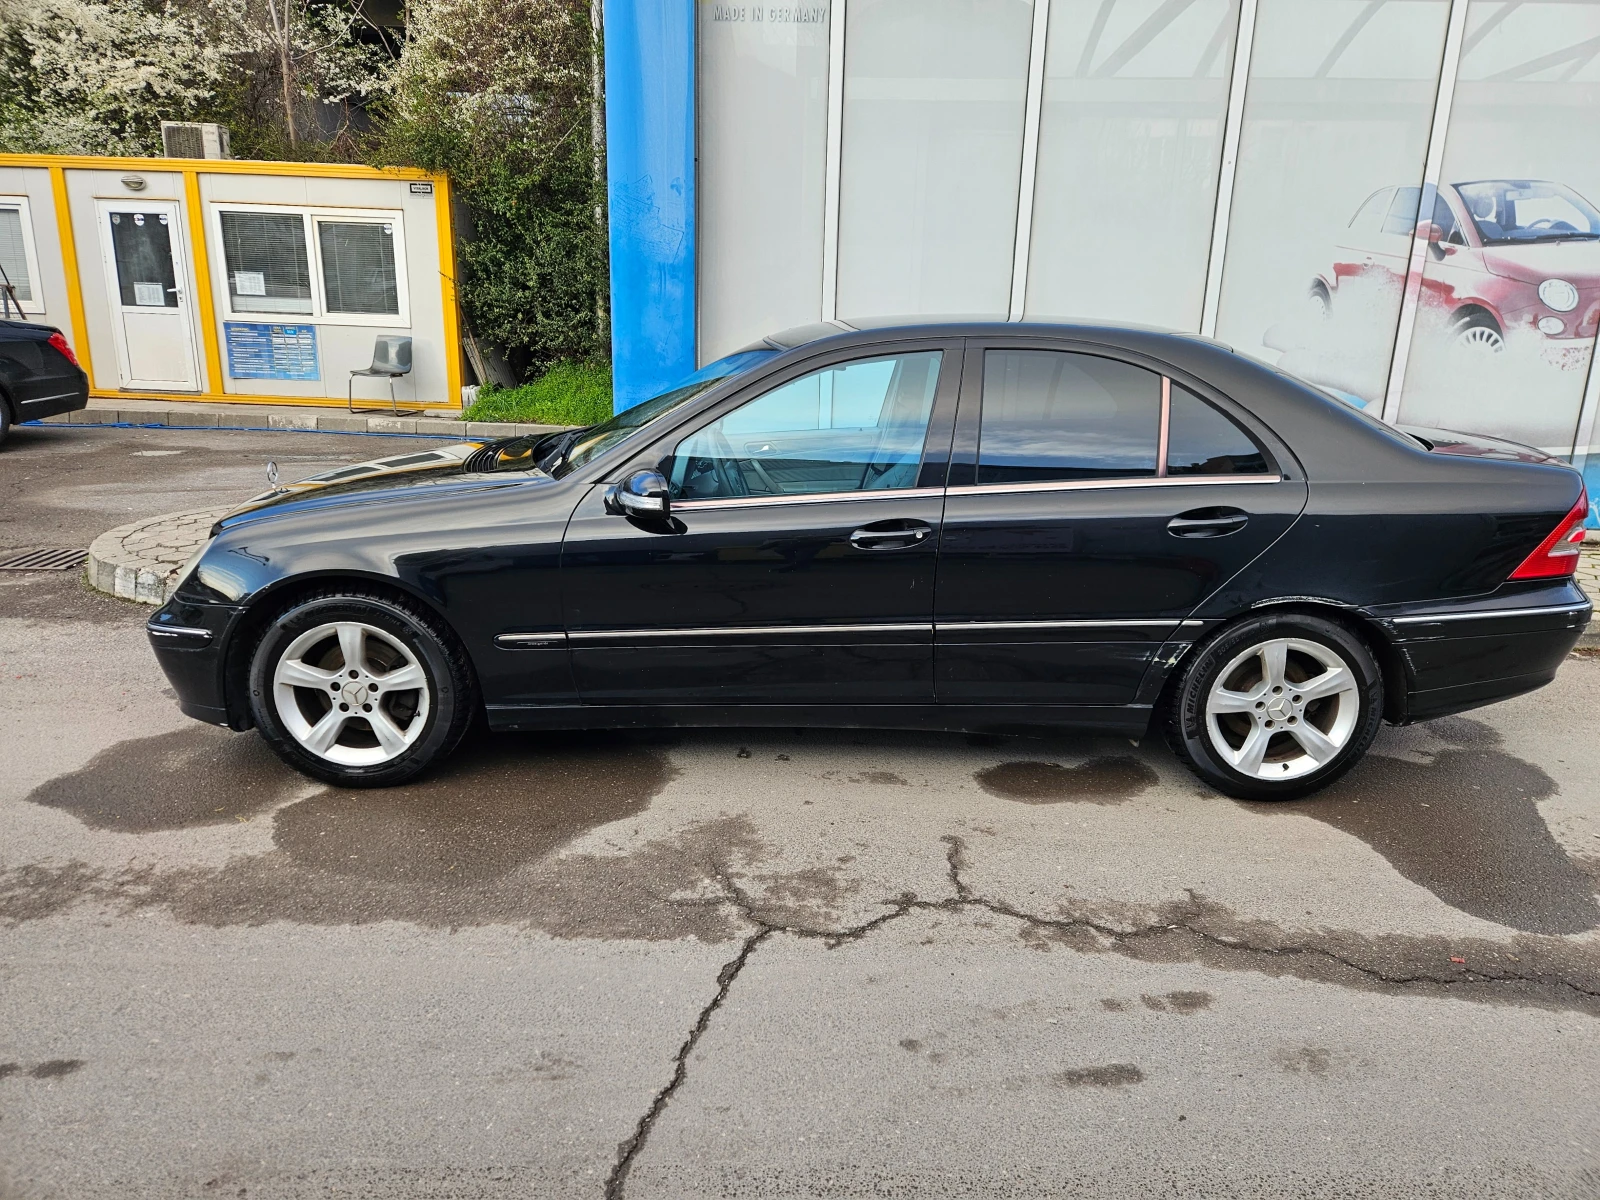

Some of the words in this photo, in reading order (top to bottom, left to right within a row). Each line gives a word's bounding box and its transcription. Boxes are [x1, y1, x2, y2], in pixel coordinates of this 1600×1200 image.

[713, 6, 745, 22] MADE
[751, 7, 763, 22] IN
[769, 7, 826, 23] GERMANY
[1187, 657, 1214, 713] MICHELIN
